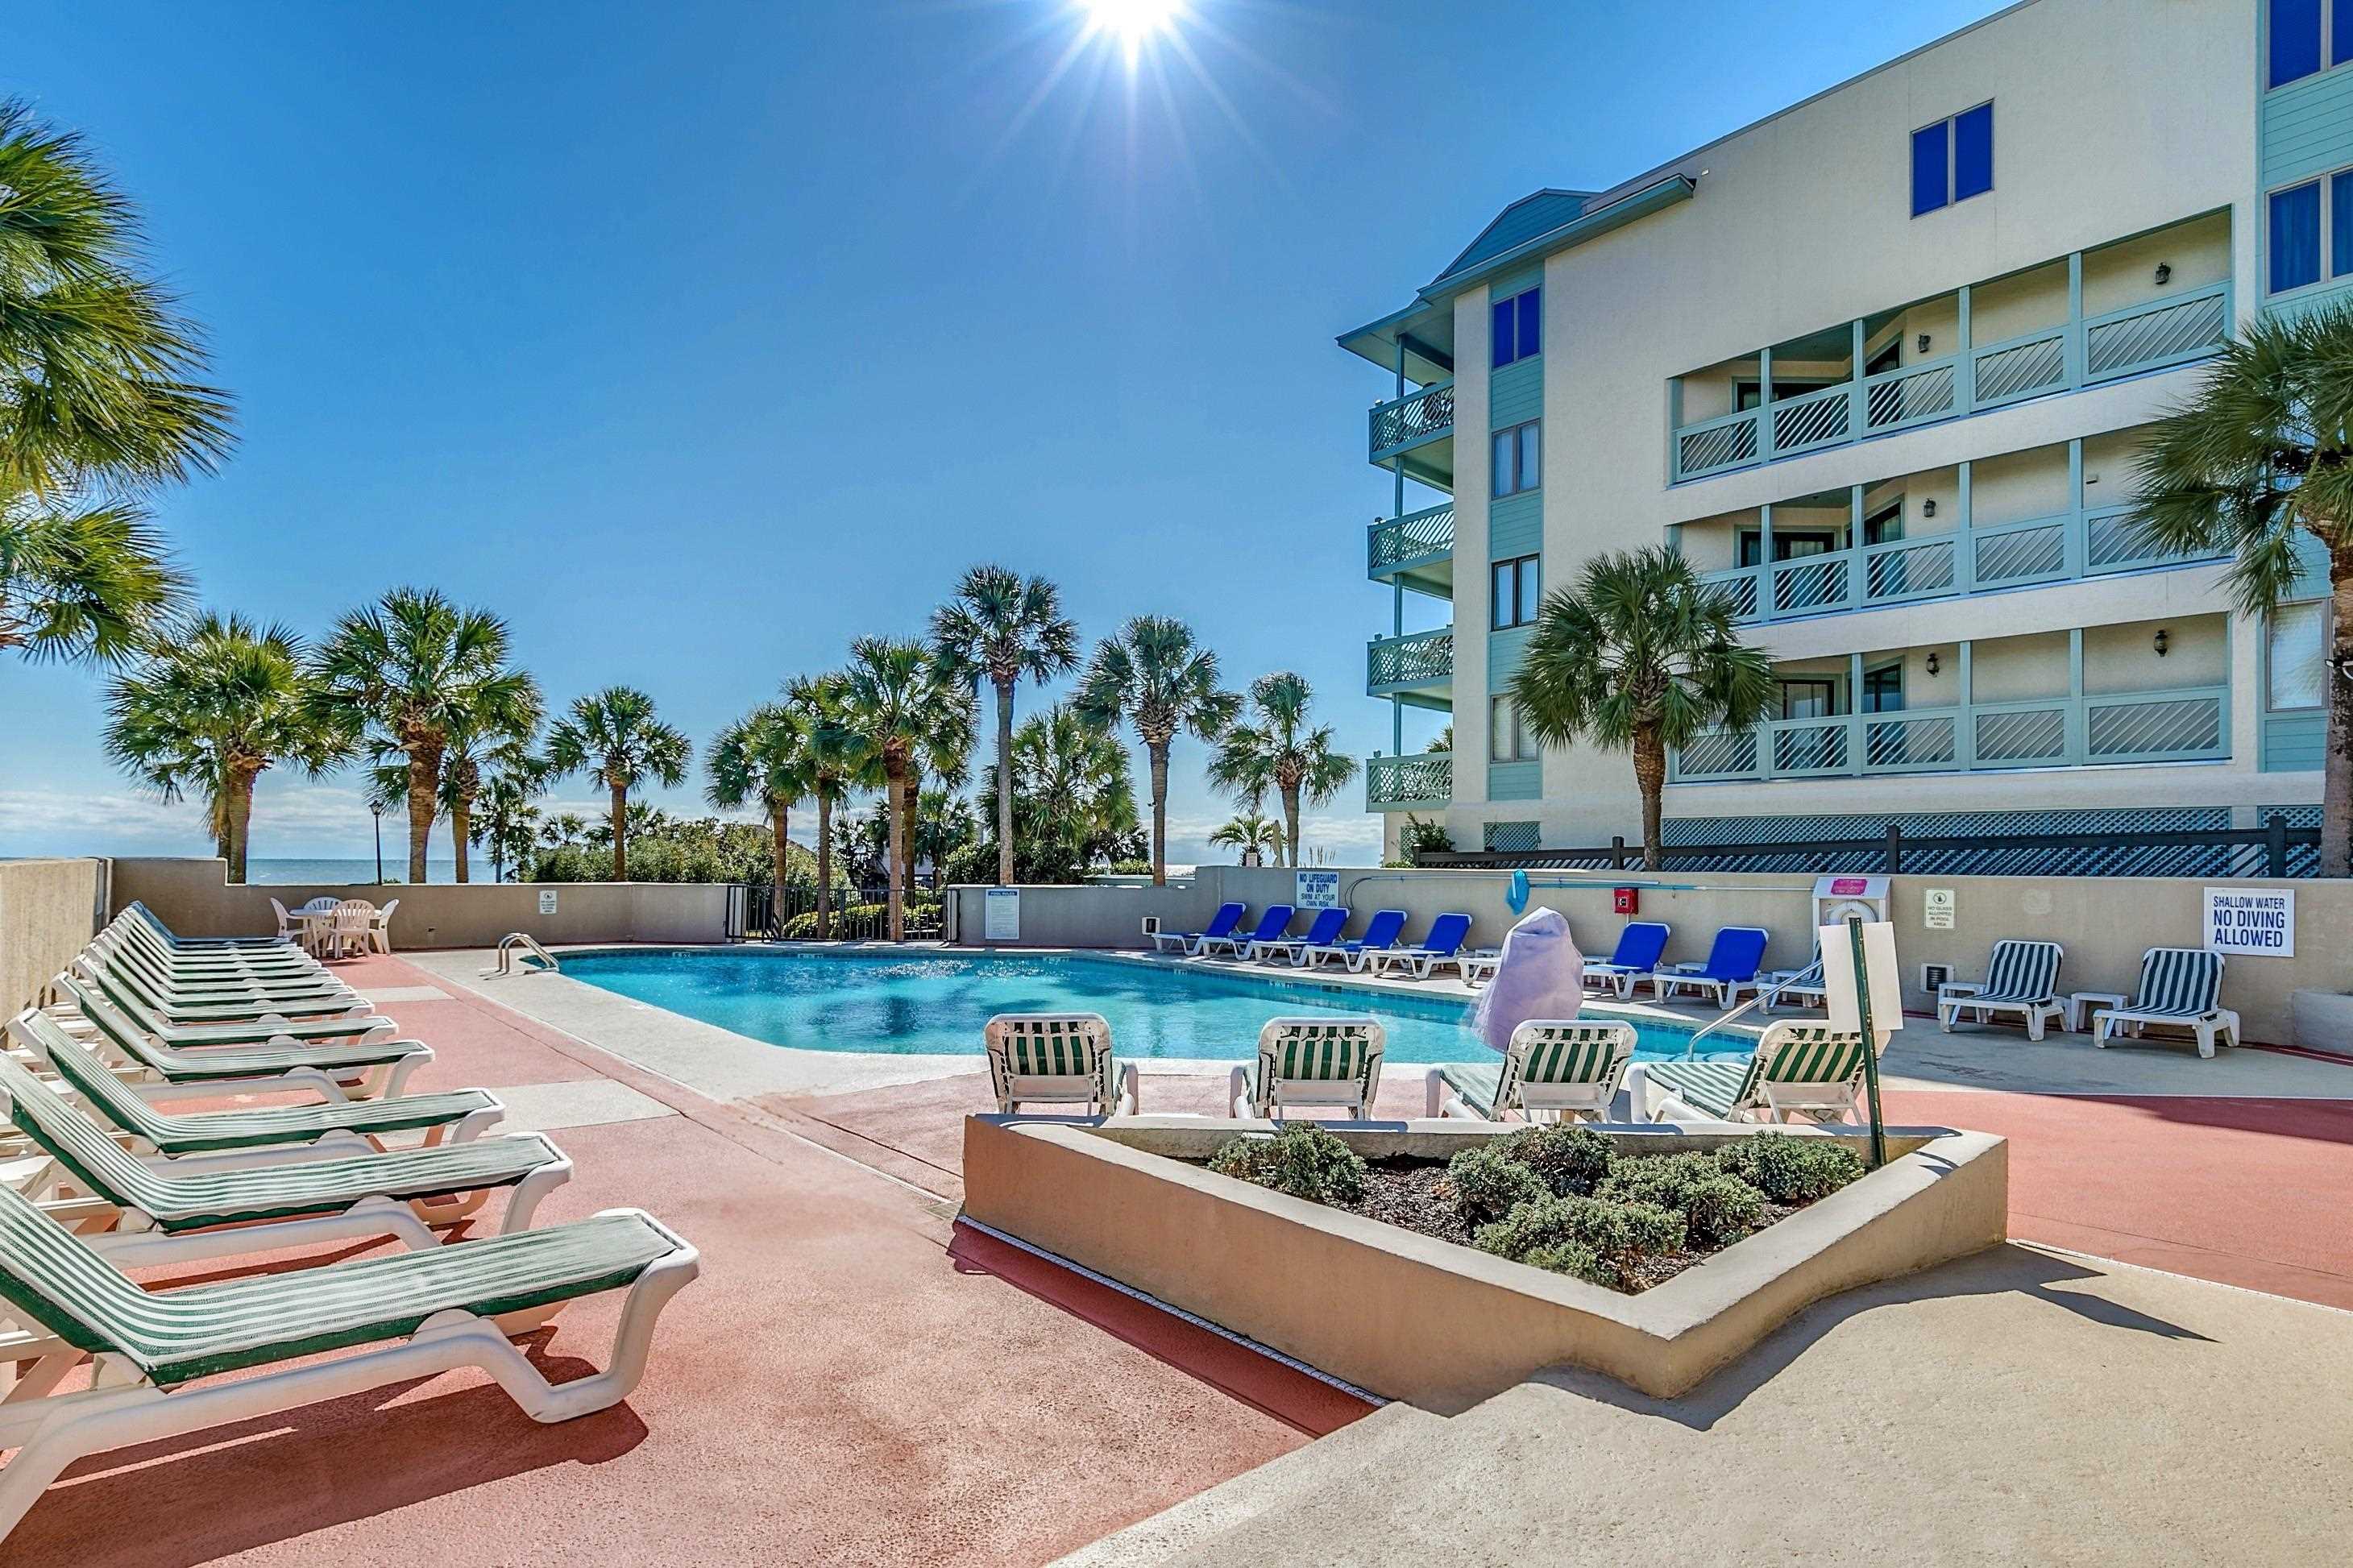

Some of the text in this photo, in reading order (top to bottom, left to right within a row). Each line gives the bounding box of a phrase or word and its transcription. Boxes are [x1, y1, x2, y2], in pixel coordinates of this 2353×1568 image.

[1299, 873, 1338, 884] NO LIFEGUARD
[1306, 883, 1330, 894] ON DUTY
[1322, 894, 1335, 902] YOUR
[2213, 895, 2285, 910] SHALLOW WATER
[2214, 909, 2285, 929] NO DIVING
[2214, 927, 2283, 948] ALLOWED
